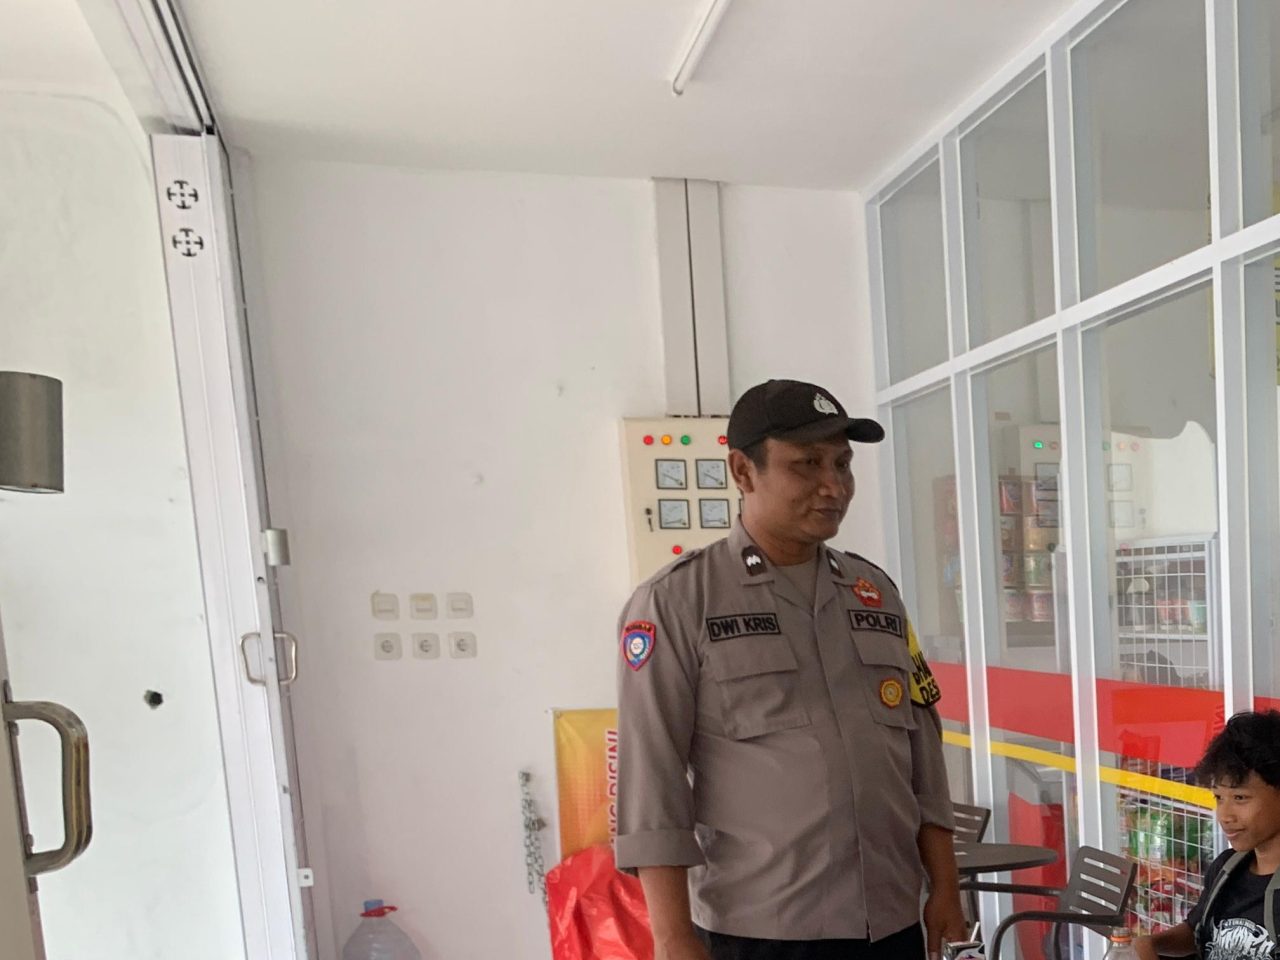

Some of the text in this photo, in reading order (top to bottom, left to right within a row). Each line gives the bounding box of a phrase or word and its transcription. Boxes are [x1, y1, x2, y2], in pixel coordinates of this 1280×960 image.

[710, 614, 778, 640] DWI KRIS
[854, 612, 898, 632] POLRI
